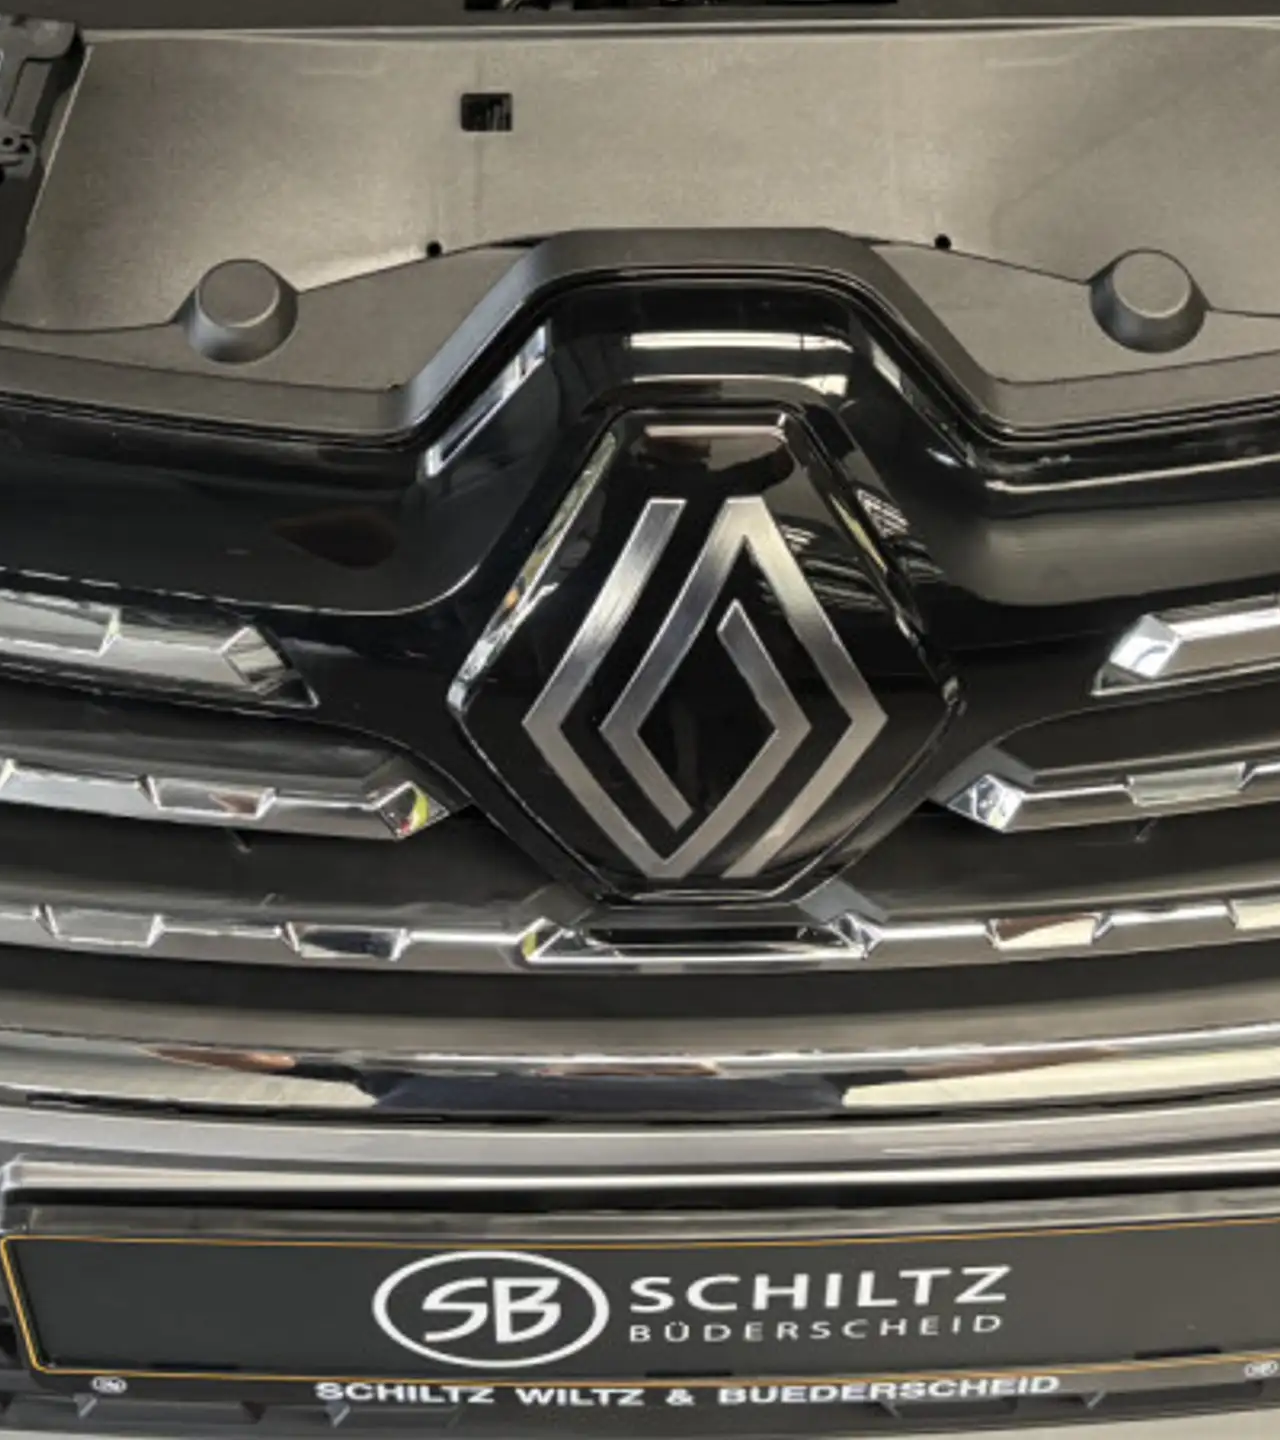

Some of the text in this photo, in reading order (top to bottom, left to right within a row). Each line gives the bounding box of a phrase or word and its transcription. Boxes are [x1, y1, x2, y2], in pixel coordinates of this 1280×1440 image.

[630, 1264, 1012, 1314] SCHILTZ
[422, 1276, 562, 1345] SB
[628, 1314, 1004, 1343] BÜDERSCHEID
[315, 1375, 1061, 1407] SCHILTZ WILTZ & BUEDERSCHEID
